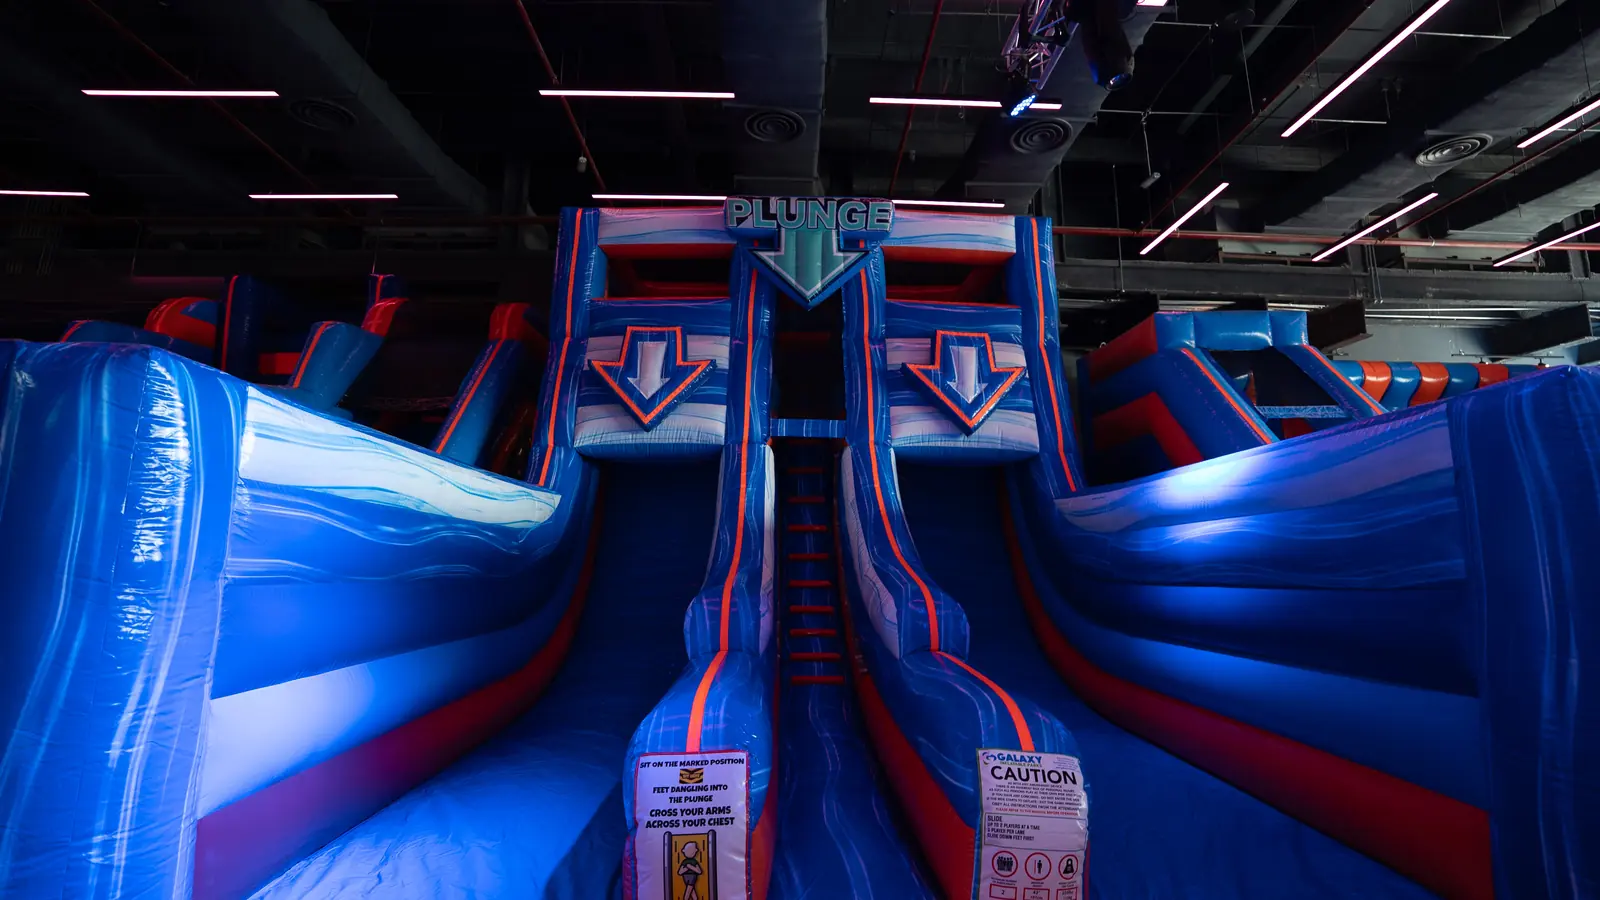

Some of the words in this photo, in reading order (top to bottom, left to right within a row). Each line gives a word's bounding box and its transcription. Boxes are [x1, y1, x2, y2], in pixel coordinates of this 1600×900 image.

[727, 197, 893, 231] PLUNGE
[997, 752, 1042, 764] GALAXY
[990, 766, 1077, 784] CAUTION
[671, 784, 708, 793] DANGLING
[650, 808, 678, 817] CROSS
[680, 807, 704, 816] YOUR
[706, 806, 731, 815] ARMS
[646, 819, 680, 828] ACROSS
[682, 819, 706, 828] YOUR
[708, 817, 735, 826] CHEST
